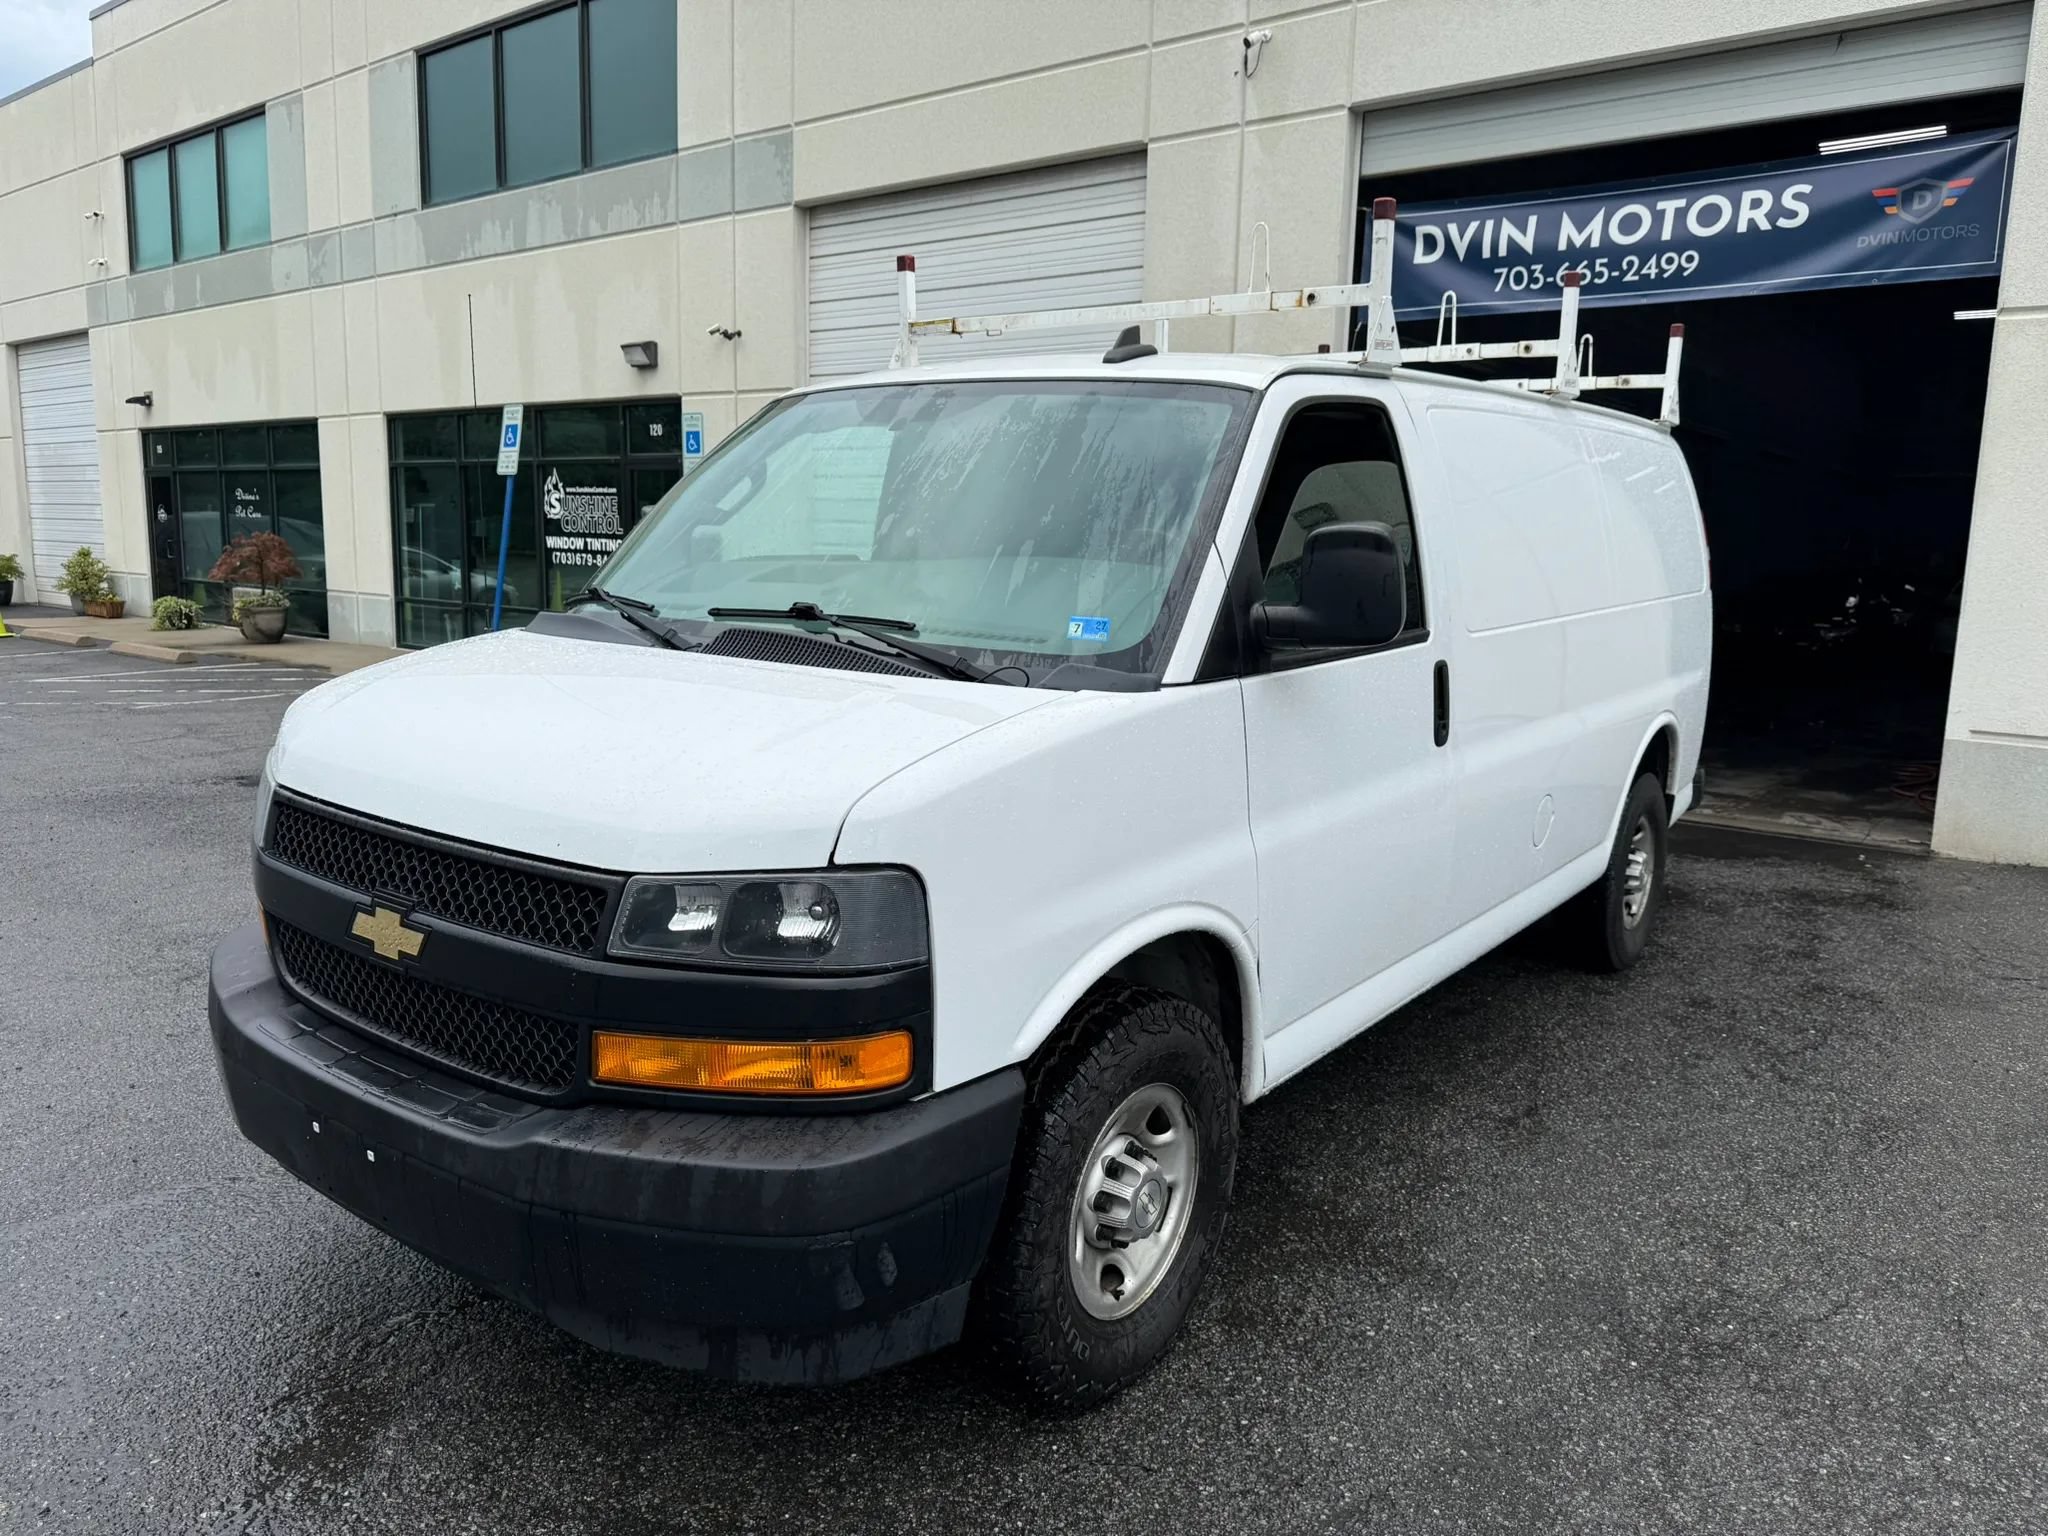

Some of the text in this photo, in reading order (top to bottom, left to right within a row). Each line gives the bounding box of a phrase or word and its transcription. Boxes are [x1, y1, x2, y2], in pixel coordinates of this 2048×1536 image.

[1413, 184, 1814, 265] DVIN MOTORS
[1493, 249, 1700, 293] 703-665-2499
[649, 424, 662, 436] 120
[549, 491, 618, 515] SUNSHINE
[561, 513, 623, 534] CONTROL
[545, 535, 584, 550] WINDOW
[1074, 623, 1081, 633] 7
